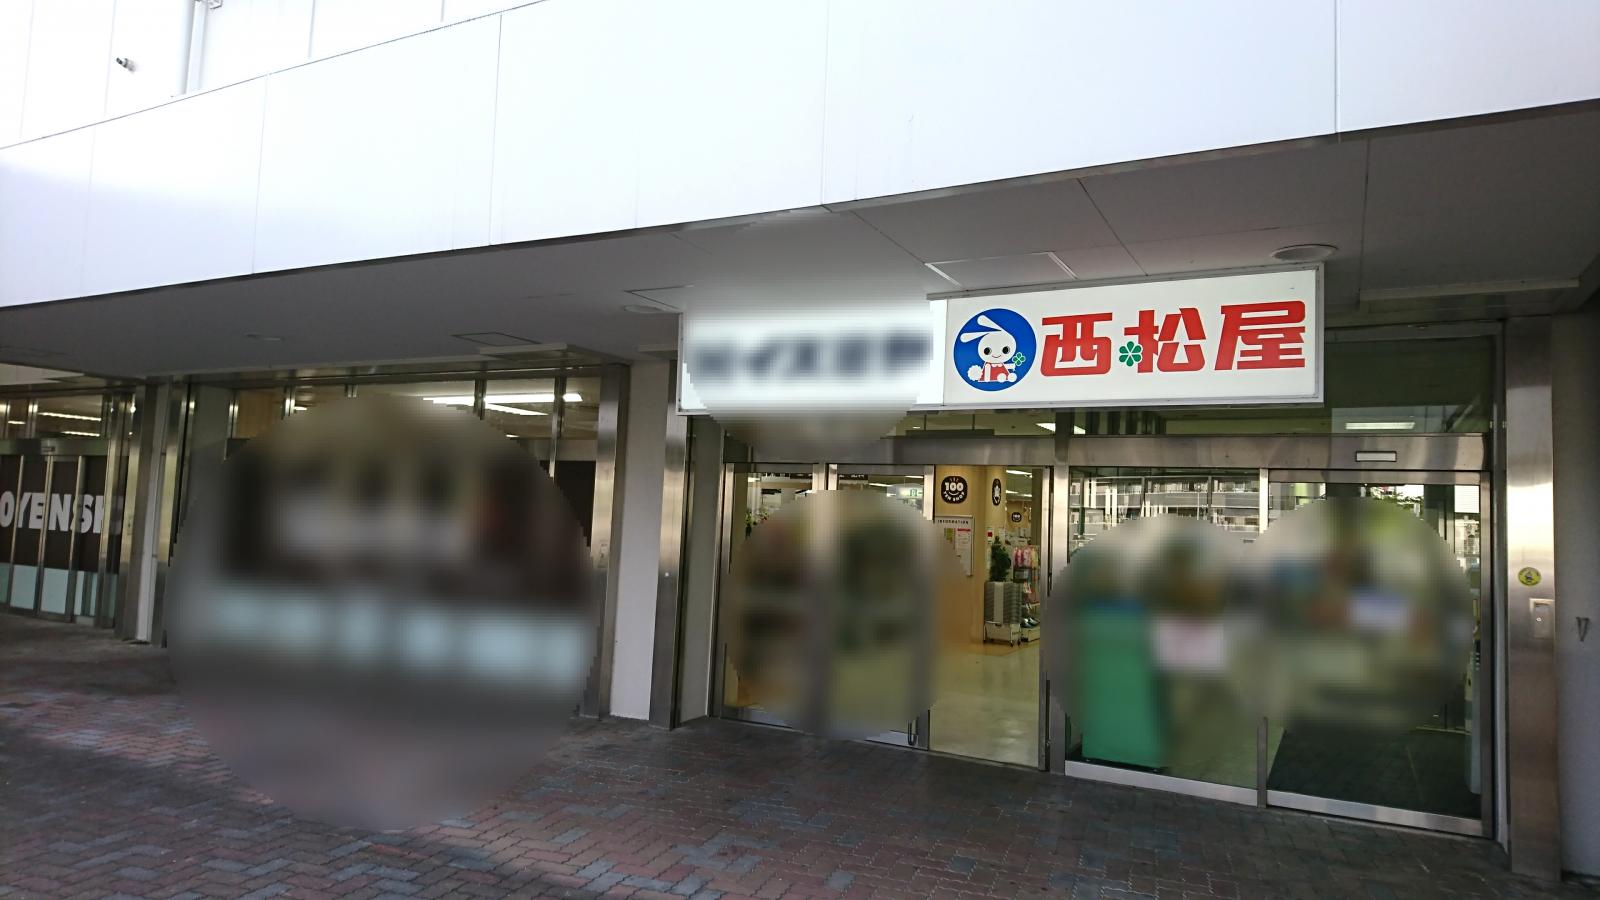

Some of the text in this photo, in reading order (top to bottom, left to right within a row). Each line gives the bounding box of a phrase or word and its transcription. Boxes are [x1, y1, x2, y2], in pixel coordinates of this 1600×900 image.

[1040, 301, 1306, 377] 西松屋
[944, 482, 964, 491] 100
